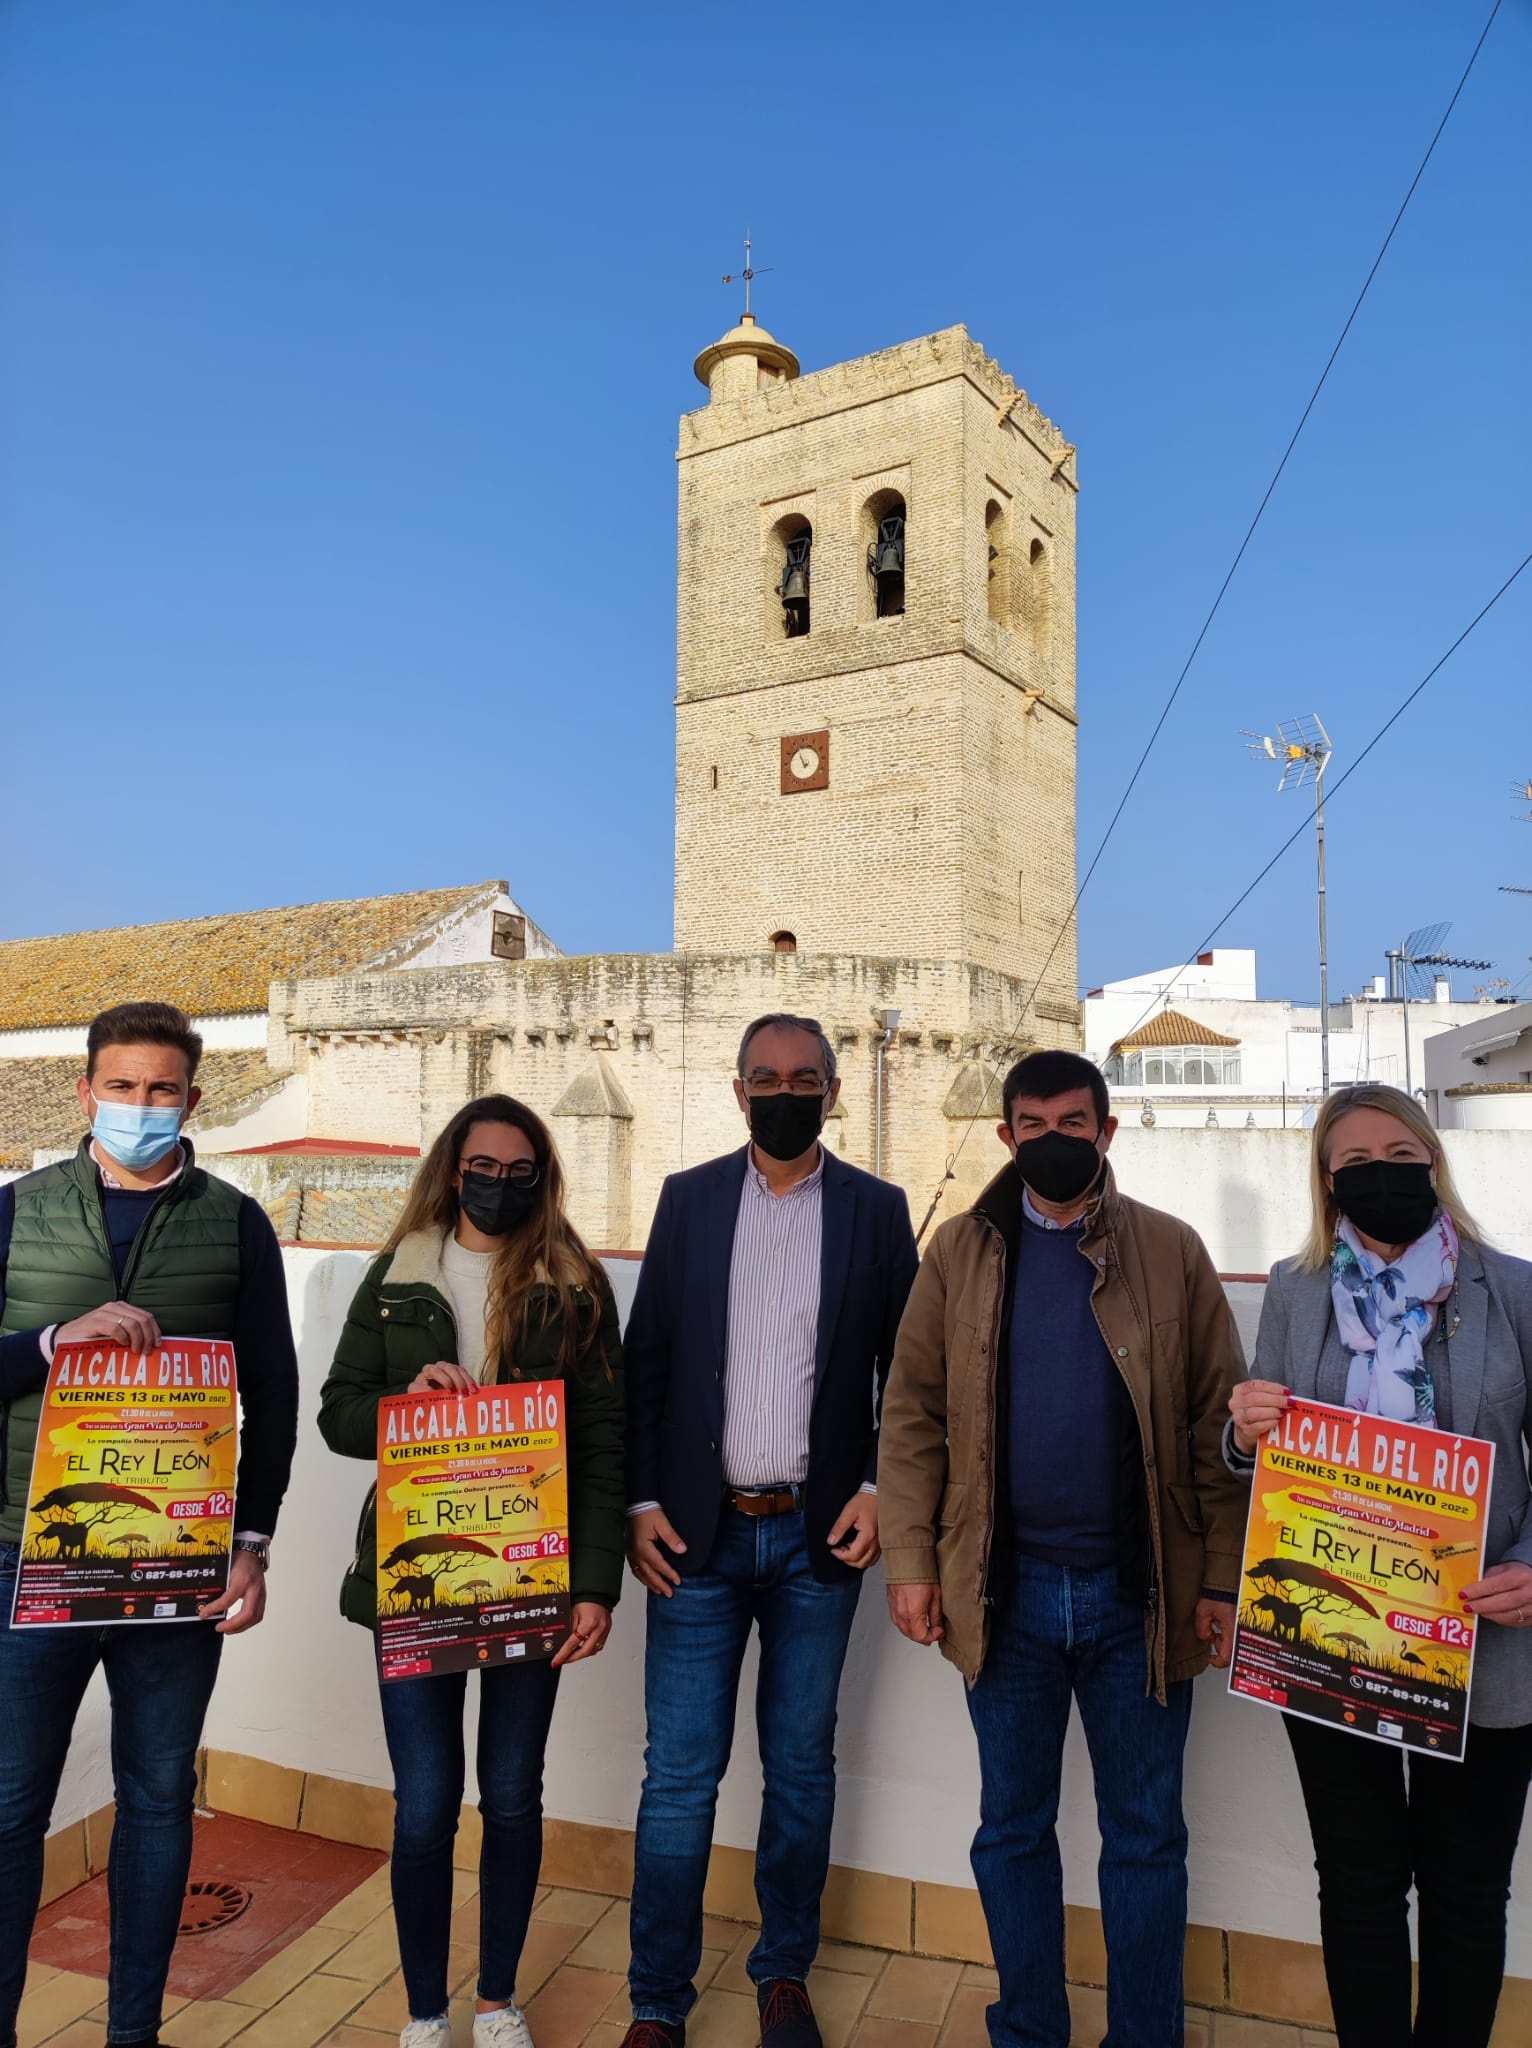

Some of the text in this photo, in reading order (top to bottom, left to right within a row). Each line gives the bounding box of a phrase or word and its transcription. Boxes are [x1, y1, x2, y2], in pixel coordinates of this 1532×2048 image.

[158, 1352, 193, 1386] DEL
[201, 1343, 230, 1387] RÍO
[58, 1391, 125, 1402] VIERNES
[130, 1391, 147, 1402] 13
[152, 1394, 165, 1402] DE
[169, 1391, 206, 1402] MAYO
[386, 1383, 558, 1444] ALCALÁ DEL RÍO
[124, 1422, 144, 1432] Gran
[165, 1422, 174, 1430] de
[174, 1421, 202, 1433] Madrid
[390, 1436, 553, 1460] VIERNES 13 DE MAYO 2022
[1267, 1412, 1480, 1497] ALCALÁ DEL RÍO
[68, 1455, 90, 1471] EL
[453, 1472, 472, 1483] Gran
[490, 1468, 500, 1478] de
[498, 1465, 528, 1479] Madrid
[110, 1476, 169, 1485] EL TRIBUTO
[1270, 1452, 1469, 1515] VIERNES 13 DE MAYO 2022
[172, 1493, 231, 1517] DESDE 12€
[407, 1509, 428, 1526] EL
[447, 1522, 501, 1535] EL TRIBUTO
[1336, 1504, 1359, 1518] Gran
[1360, 1510, 1380, 1523] Vía
[1381, 1516, 1394, 1527] de
[1392, 1520, 1430, 1537] Madrid
[508, 1533, 565, 1560] DESDE 12€
[1280, 1526, 1303, 1549] EL
[1323, 1562, 1388, 1588] EL TRIBUTO
[1394, 1614, 1470, 1646] DESDE 12€
[1365, 1681, 1449, 1711] 627-69-67-54
